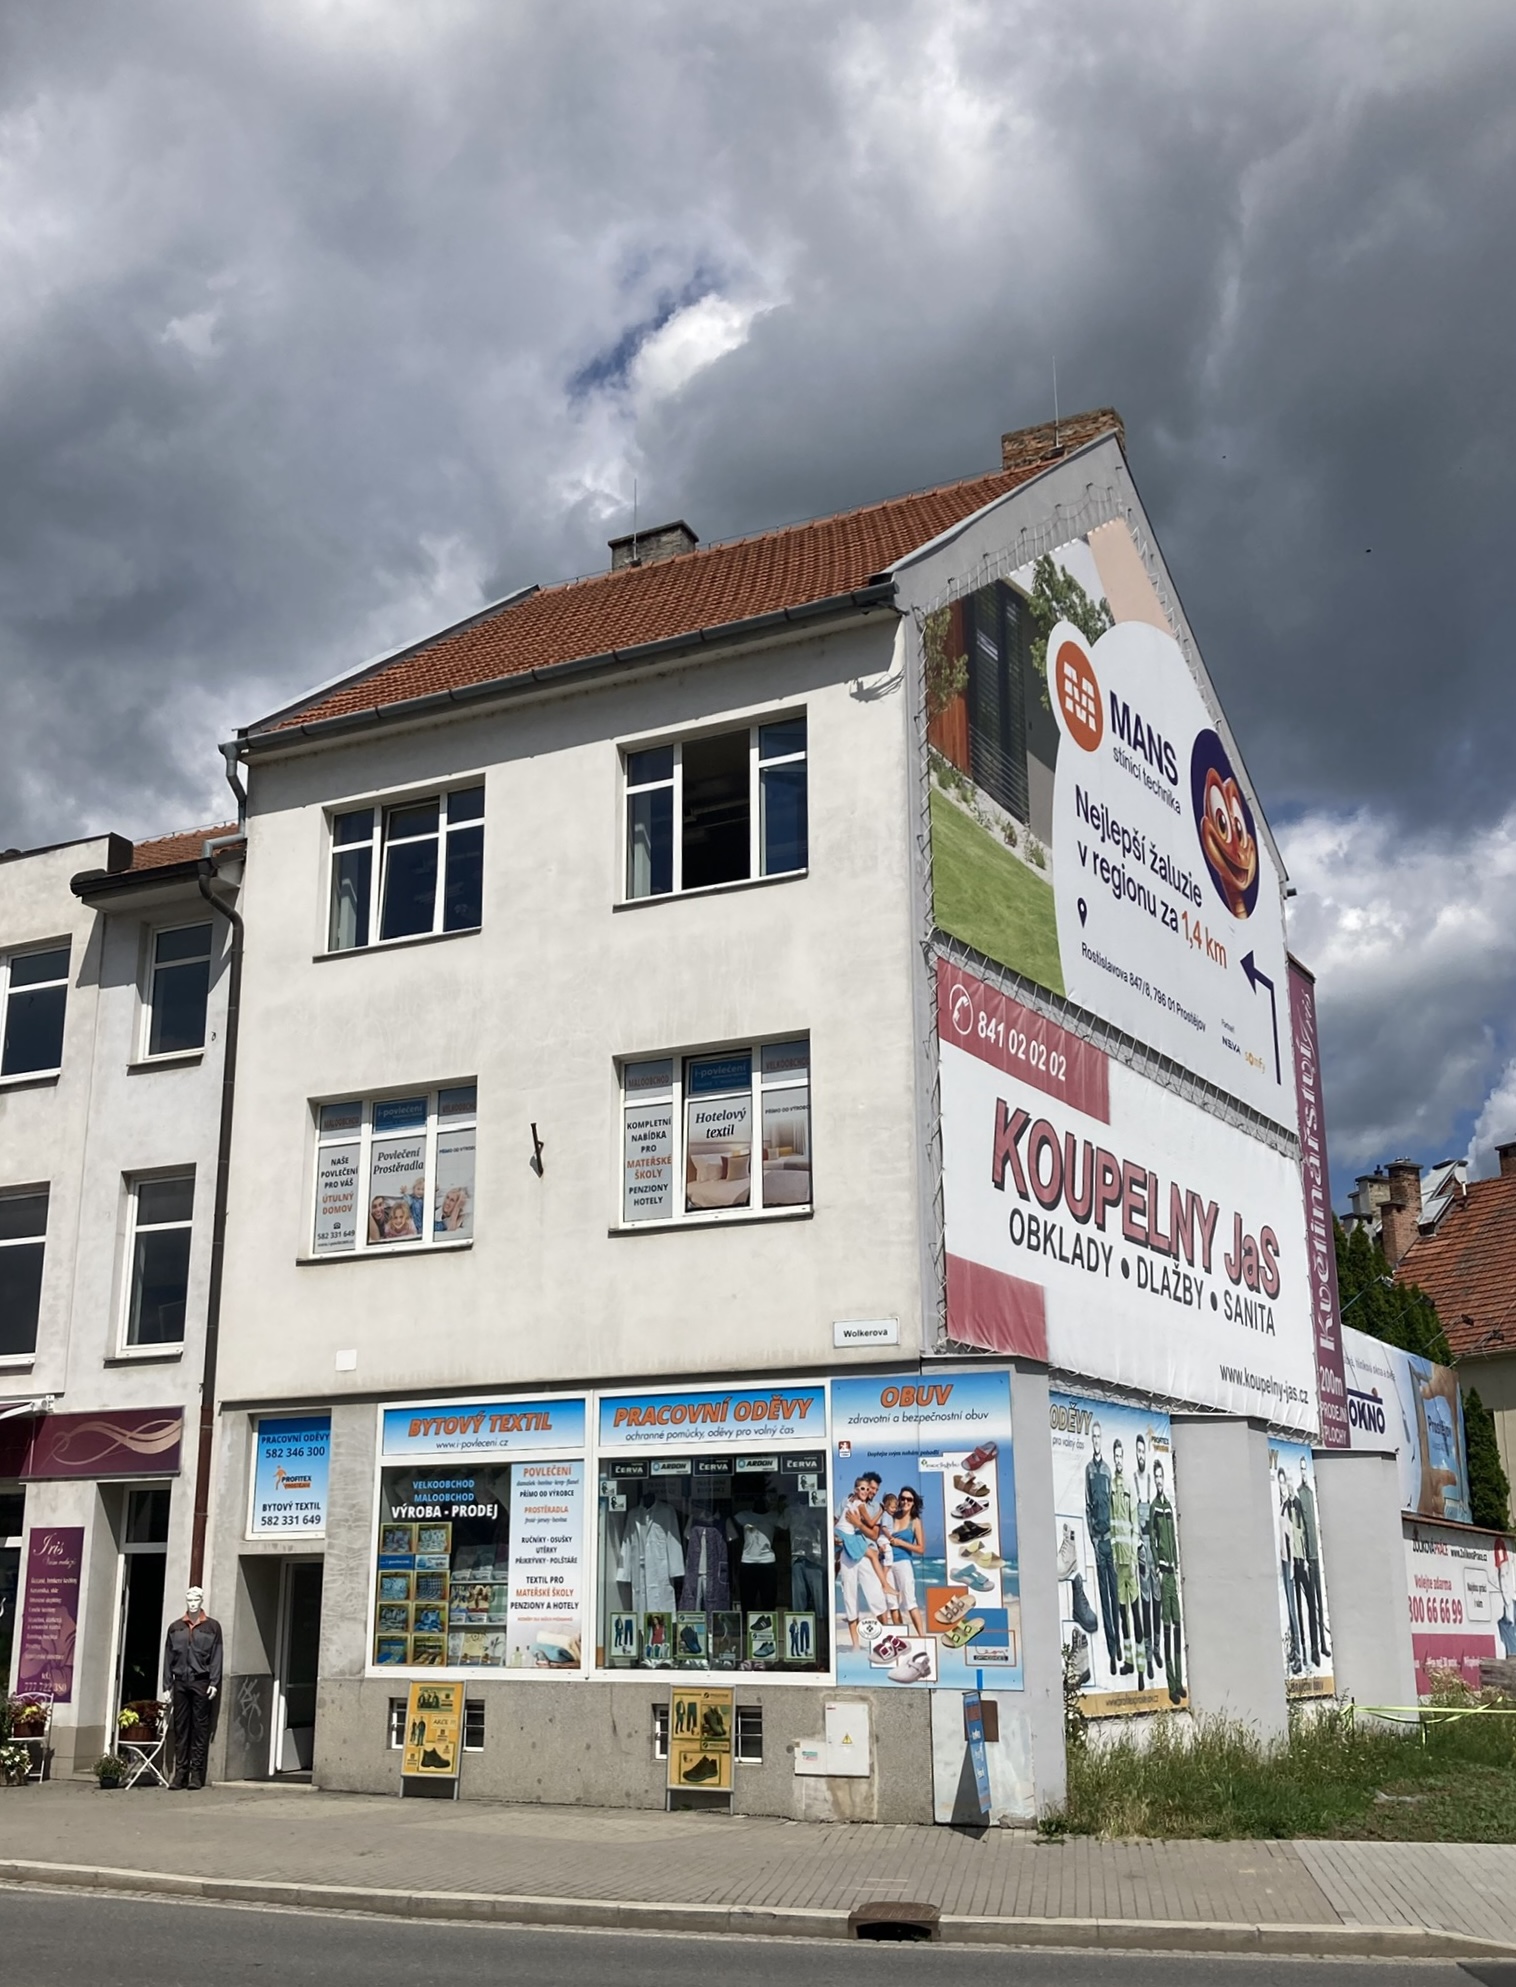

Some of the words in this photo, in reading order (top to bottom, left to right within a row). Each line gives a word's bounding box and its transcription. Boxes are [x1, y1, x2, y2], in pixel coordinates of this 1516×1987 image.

[1110, 690, 1179, 786] MANS
[1142, 768, 1181, 815] technika
[1075, 784, 1146, 866] Nejlepší
[1150, 841, 1202, 908] žaluzie
[1077, 841, 1088, 868] v
[1092, 851, 1157, 918] regionu
[1161, 901, 1179, 933] za
[1182, 911, 1203, 949] 1,4
[1205, 927, 1227, 969] km
[1081, 942, 1129, 982] Rostislavova
[1153, 987, 1167, 1007] 796
[1167, 997, 1177, 1012] 01
[1176, 1002, 1206, 1033] Prostějov
[977, 1011, 1005, 1048] 841
[1009, 1029, 1026, 1060] 02
[1029, 1040, 1046, 1072] 02
[1050, 1051, 1067, 1081] 02
[1222, 1036, 1241, 1055] NEVA
[1245, 1051, 1266, 1074] somfy
[694, 1062, 747, 1078] i-povlečení
[378, 1103, 423, 1118] i-povlečení
[695, 1107, 747, 1124] Hotelový
[627, 1117, 671, 1130] KOMPLETNÍ
[631, 1130, 667, 1142] NABÍDKA
[706, 1124, 734, 1139] textil
[377, 1147, 421, 1161] Povlečení
[640, 1144, 657, 1153] PRO
[331, 1156, 349, 1166] NAŠE
[373, 1160, 424, 1175] Prostěradla
[627, 1155, 672, 1168] MATEŘSKÉ
[321, 1166, 358, 1179] POVLEČENÍ
[634, 1168, 662, 1180] ŠKOLY
[324, 1180, 339, 1189] PRO
[340, 1178, 354, 1187] VÁŠ
[628, 1184, 669, 1194] PENZIONY
[322, 1192, 354, 1204] ÚTULNÝ
[634, 1196, 663, 1206] HOTELY
[992, 1096, 1220, 1274] KOUPELNY
[1224, 1212, 1281, 1300] JaS
[322, 1204, 352, 1215] DOMOV
[317, 1232, 329, 1240] 582
[330, 1231, 341, 1239] 331
[1009, 1207, 1114, 1278] OBKLADY
[1137, 1255, 1204, 1310] DLAŽBY
[1223, 1289, 1276, 1337] SANITA
[1219, 1364, 1309, 1406] www.koupelny-jas.cz
[1320, 1366, 1344, 1397] 200m
[880, 1384, 954, 1408] OBUV
[613, 1396, 732, 1427] PRACOVNÍ
[733, 1394, 814, 1422] ODĚVY
[848, 1412, 891, 1424] zdravotní
[893, 1415, 900, 1423] a
[902, 1410, 963, 1425] bezpečnostní
[965, 1408, 989, 1420] obuv
[1320, 1400, 1348, 1423] PRODEJNÍ
[1349, 1398, 1386, 1434] OKNO
[408, 1410, 486, 1437] BYTOVÝ
[489, 1411, 553, 1433] TEXTIL
[1050, 1402, 1094, 1436] ODĚVY
[261, 1432, 301, 1444] PRACOVNÍ
[303, 1430, 331, 1442] ODĚVY
[625, 1429, 665, 1441] ochranné
[666, 1427, 705, 1442] pomůcky,
[707, 1426, 734, 1439] oděvy
[736, 1428, 752, 1438] pro
[753, 1424, 778, 1436] volný
[779, 1425, 794, 1435] čas
[1323, 1424, 1347, 1445] PLOCHY
[436, 1437, 509, 1450] www.i-povleceni.cz
[1052, 1438, 1062, 1447] pro
[1062, 1436, 1076, 1451] volný
[1076, 1439, 1085, 1450] čas
[266, 1448, 283, 1458] 582
[286, 1447, 304, 1458] 346
[307, 1446, 325, 1457] 300
[615, 1465, 643, 1474] ČERVA
[699, 1462, 728, 1471] ČERVA
[786, 1459, 818, 1468] ČERVA
[523, 1464, 572, 1477] POVLEČENÍ
[281, 1475, 312, 1483] PROFITEX
[412, 1479, 475, 1490] VELKOOBCHOD
[414, 1493, 475, 1503] MALOOBCHOD
[520, 1489, 538, 1497] PŘÍMO
[549, 1489, 574, 1497] VÝROBCE
[262, 1501, 293, 1512] BYTOVÝ
[295, 1502, 321, 1511] TEXTIL
[391, 1502, 442, 1519] VÝROBA
[452, 1503, 498, 1520] PRODEJ
[524, 1505, 569, 1514] PROSTĚRADLA
[261, 1516, 279, 1526] 582
[282, 1515, 299, 1525] 331
[302, 1514, 321, 1524] 649
[33, 1532, 64, 1555] Iris
[521, 1535, 546, 1543] RUČNÍKY
[550, 1535, 572, 1543] OSUŠKY
[536, 1545, 557, 1554] UTĚRKY
[515, 1556, 546, 1564] PŘIKRÝVKY
[550, 1555, 578, 1564] POLŠTÁŘE
[526, 1576, 548, 1584] TEXTIL
[550, 1576, 564, 1584] PRO
[1434, 1577, 1452, 1591] zdarma
[516, 1587, 550, 1597] MATEŘSKÉ
[552, 1587, 574, 1597] ŠKOLY
[510, 1602, 545, 1610] PENZIONY
[546, 1602, 552, 1610] A
[553, 1602, 579, 1610] HOTELY
[1427, 1597, 1438, 1623] 66
[1440, 1597, 1450, 1623] 66
[1452, 1598, 1463, 1624] 99
